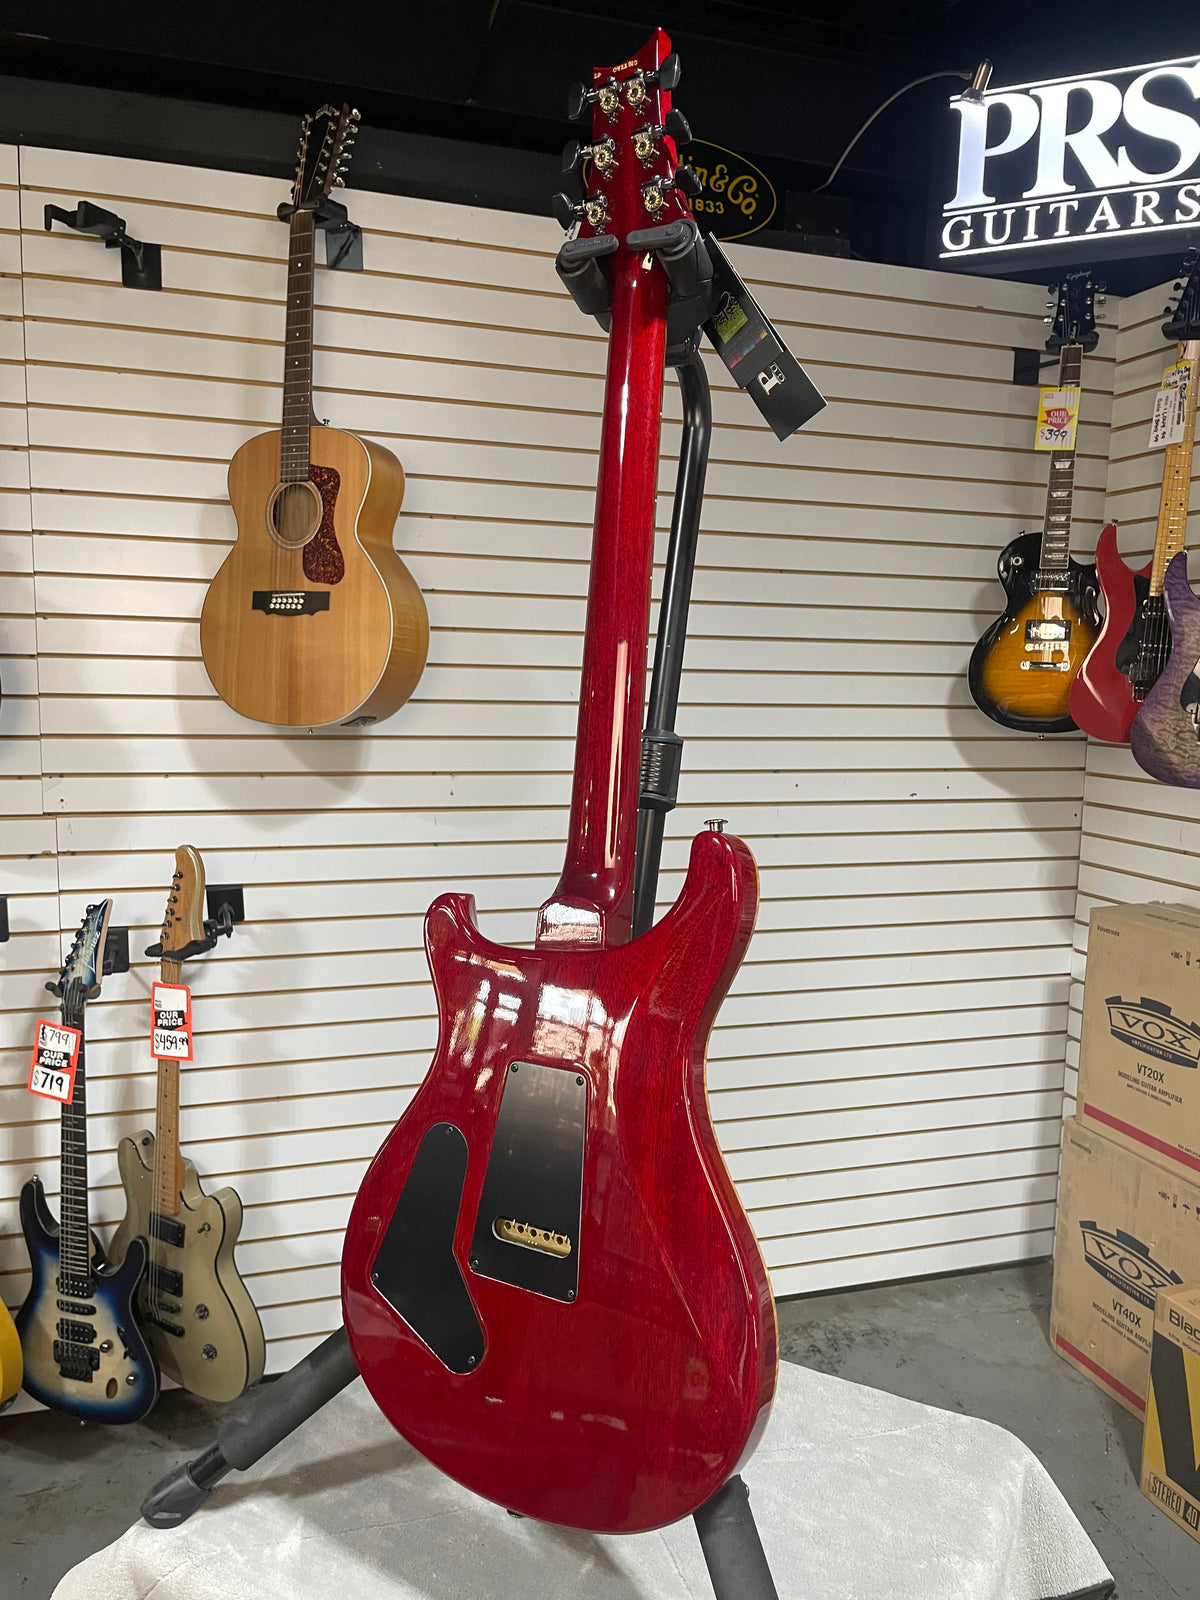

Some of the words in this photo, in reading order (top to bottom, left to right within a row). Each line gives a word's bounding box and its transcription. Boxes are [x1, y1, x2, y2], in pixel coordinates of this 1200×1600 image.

[943, 62, 1200, 210] PRS
[688, 198, 725, 215] 1833
[941, 184, 1200, 251] GUITARS
[1047, 417, 1068, 425] PRICE
[1051, 410, 1068, 418] OUR
[1040, 428, 1068, 441] $399
[157, 1018, 184, 1027] PRICE
[159, 1011, 179, 1019] OUR
[1116, 1010, 1192, 1052] VOX
[38, 1056, 69, 1068] PRICE
[42, 1050, 64, 1060] OUR
[32, 1069, 64, 1092] $719
[1136, 1062, 1165, 1084] VT20X
[1140, 1080, 1157, 1092] GUITAR
[1091, 1237, 1168, 1293] VOX
[1112, 1298, 1141, 1329] VT40X
[1151, 1476, 1182, 1514] STEREO
[1185, 1505, 1198, 1527] 40
